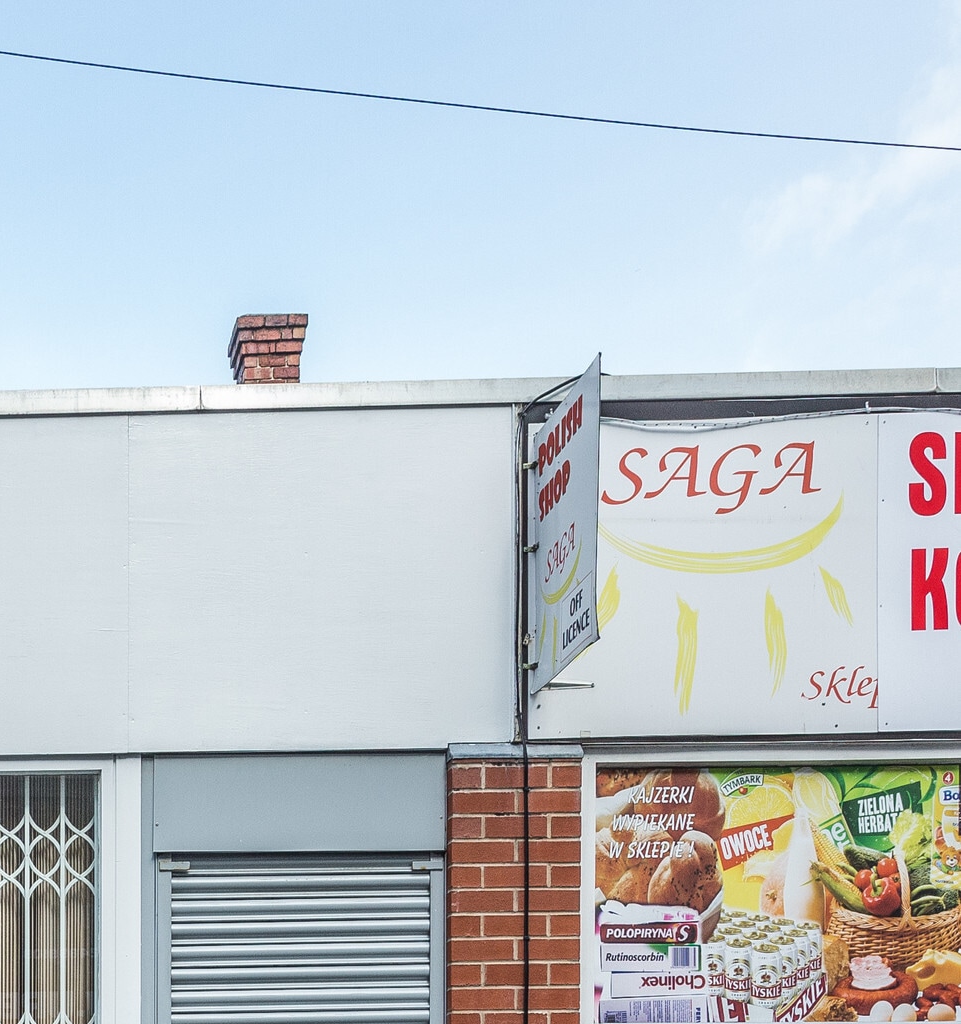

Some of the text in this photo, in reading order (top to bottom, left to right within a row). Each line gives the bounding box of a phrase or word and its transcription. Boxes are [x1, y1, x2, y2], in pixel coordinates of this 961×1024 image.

[539, 394, 583, 477] POLISH
[601, 440, 822, 515] SAGA
[539, 460, 570, 521] SHOP
[545, 522, 575, 583] SAGA
[911, 547, 961, 631] K
[569, 588, 583, 617] OFF
[562, 608, 590, 650] LICENCE
[628, 786, 695, 804] KAJZERKI
[723, 775, 761, 793] TYMBARK
[857, 792, 904, 817] ZIELONA
[612, 814, 695, 831] WYPIEKANE
[858, 811, 901, 834] HERBAT
[609, 841, 624, 858] W
[627, 841, 684, 858] SKLEPIE
[720, 824, 772, 860] OWOCE
[606, 925, 690, 941] POLOPIRYNA S
[605, 952, 665, 962] Rutinoscorbin
[641, 974, 706, 990] Cholinex
[751, 984, 781, 998] TYSKIE
